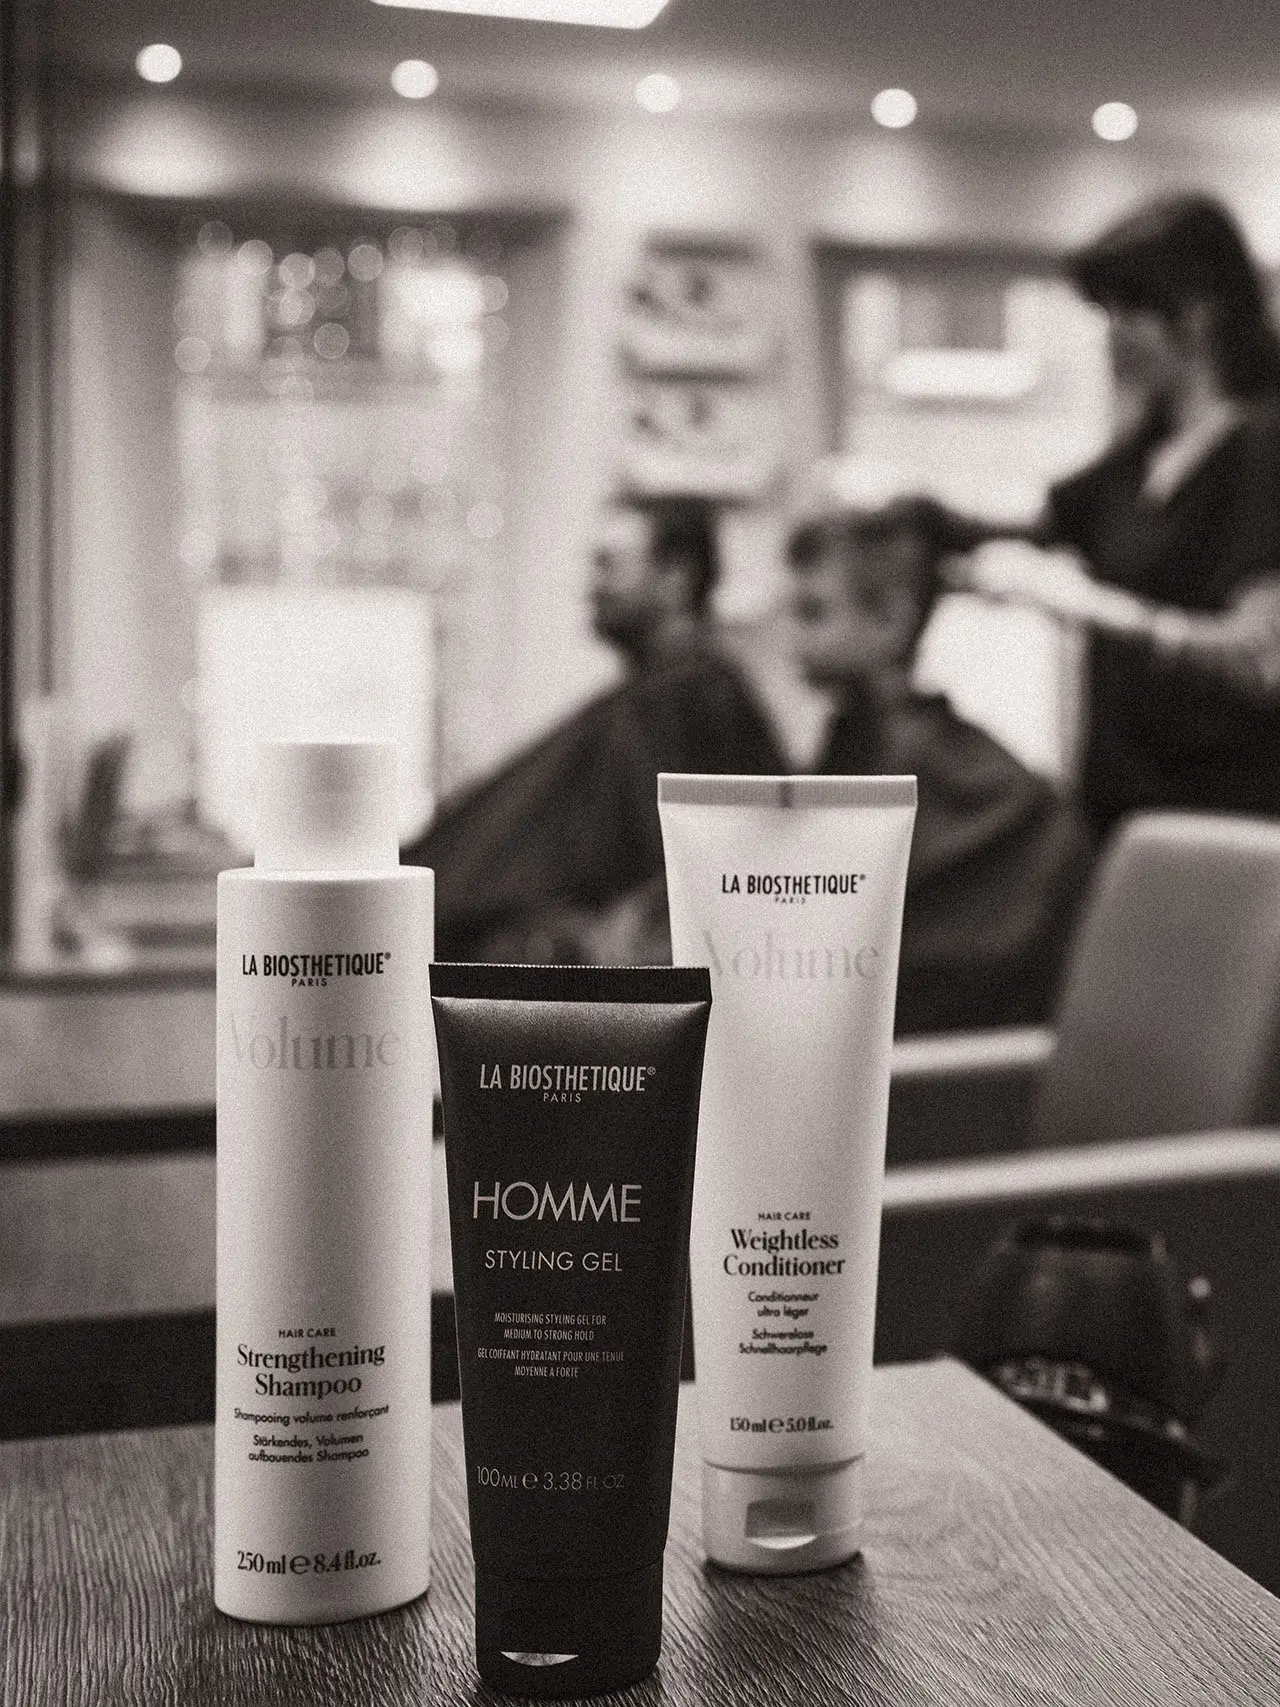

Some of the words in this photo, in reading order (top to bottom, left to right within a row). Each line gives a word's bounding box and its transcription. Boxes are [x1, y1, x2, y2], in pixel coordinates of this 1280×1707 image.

[722, 874, 740, 894] LA
[775, 897, 806, 905] PARIS
[243, 954, 258, 975] LA
[292, 978, 328, 987] PARIS
[480, 1064, 502, 1089] LA
[543, 1093, 582, 1103] PARIS
[472, 1181, 642, 1223] HOMME
[758, 1212, 782, 1221] HAIR
[784, 1211, 811, 1221] CARE
[731, 1228, 839, 1254] Weightless
[485, 1250, 574, 1271] STYLING
[582, 1252, 623, 1272] GEL
[723, 1253, 846, 1277] Conditioner
[748, 1291, 819, 1302] Conditionneur
[757, 1305, 781, 1317] ultra
[494, 1312, 544, 1325] MOISTURISING
[545, 1314, 575, 1325] STYLING
[577, 1314, 589, 1325] GEL
[592, 1315, 607, 1326] FOR
[279, 1328, 304, 1338] HAIR
[307, 1327, 336, 1338] CARE
[504, 1329, 531, 1340] MEDIUM
[533, 1329, 542, 1340] TO
[544, 1330, 572, 1341] STRONG
[574, 1330, 594, 1341] HOLD
[237, 1343, 385, 1374] Strengthening
[478, 1348, 488, 1358] GEL
[489, 1348, 519, 1360] COIFFANT
[520, 1350, 561, 1361] HYDRATANT
[563, 1351, 584, 1362] POUR
[585, 1351, 599, 1362] UNE
[602, 1351, 624, 1362] TENUE
[514, 1366, 547, 1377] MOYENNE
[556, 1366, 578, 1378] FORTE
[255, 1373, 362, 1400] Shampoo
[234, 1408, 290, 1427] Shampooing
[293, 1412, 333, 1424] volume
[337, 1405, 390, 1421] renforçant
[253, 1434, 313, 1449] Stärkendes,
[315, 1434, 364, 1446] Volumen
[248, 1450, 314, 1464] aufbauendes
[316, 1449, 370, 1463] Shampoo
[543, 1471, 582, 1490] 3.38
